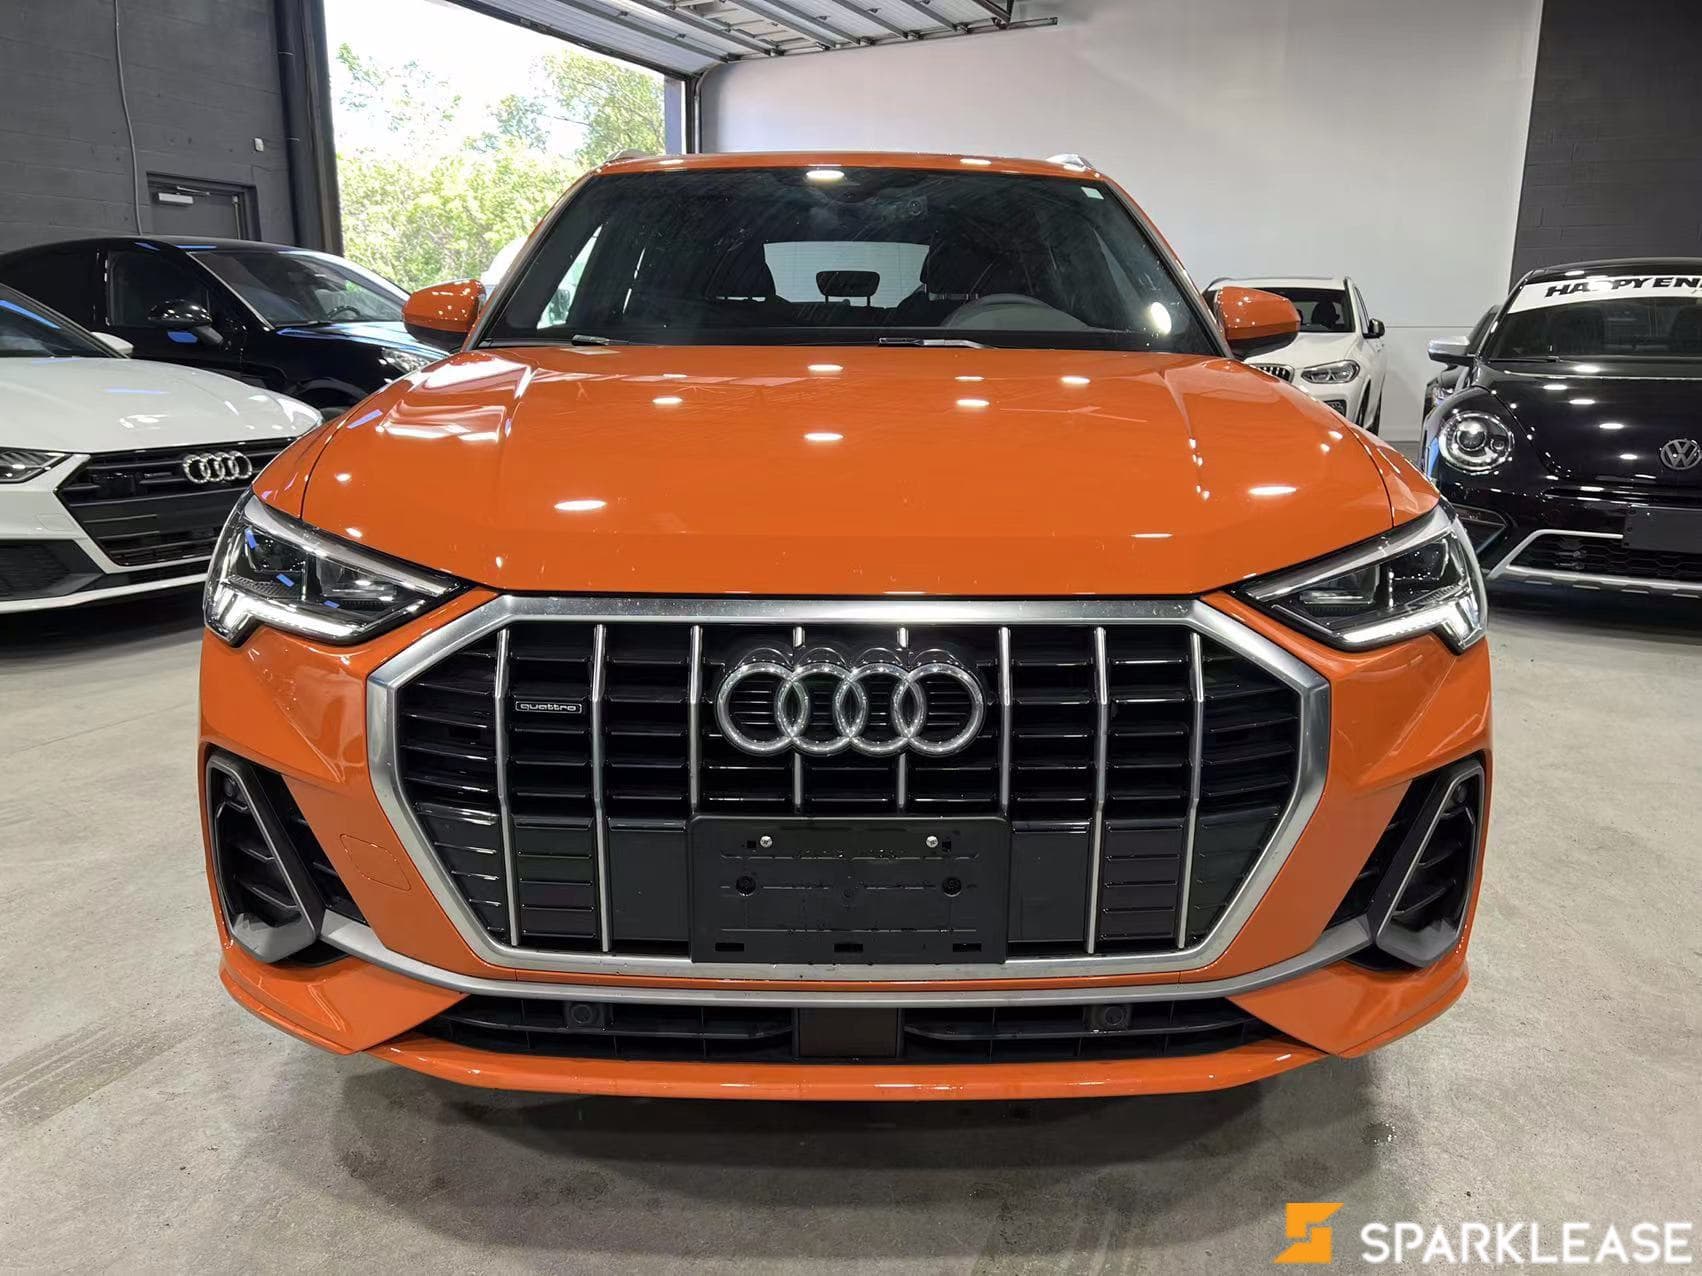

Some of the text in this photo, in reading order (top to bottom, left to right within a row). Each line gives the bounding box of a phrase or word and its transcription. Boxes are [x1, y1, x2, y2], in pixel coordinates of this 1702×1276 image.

[1545, 277, 1702, 297] HAPYEN
[1661, 439, 1700, 469] VW
[520, 703, 577, 711] quattro
